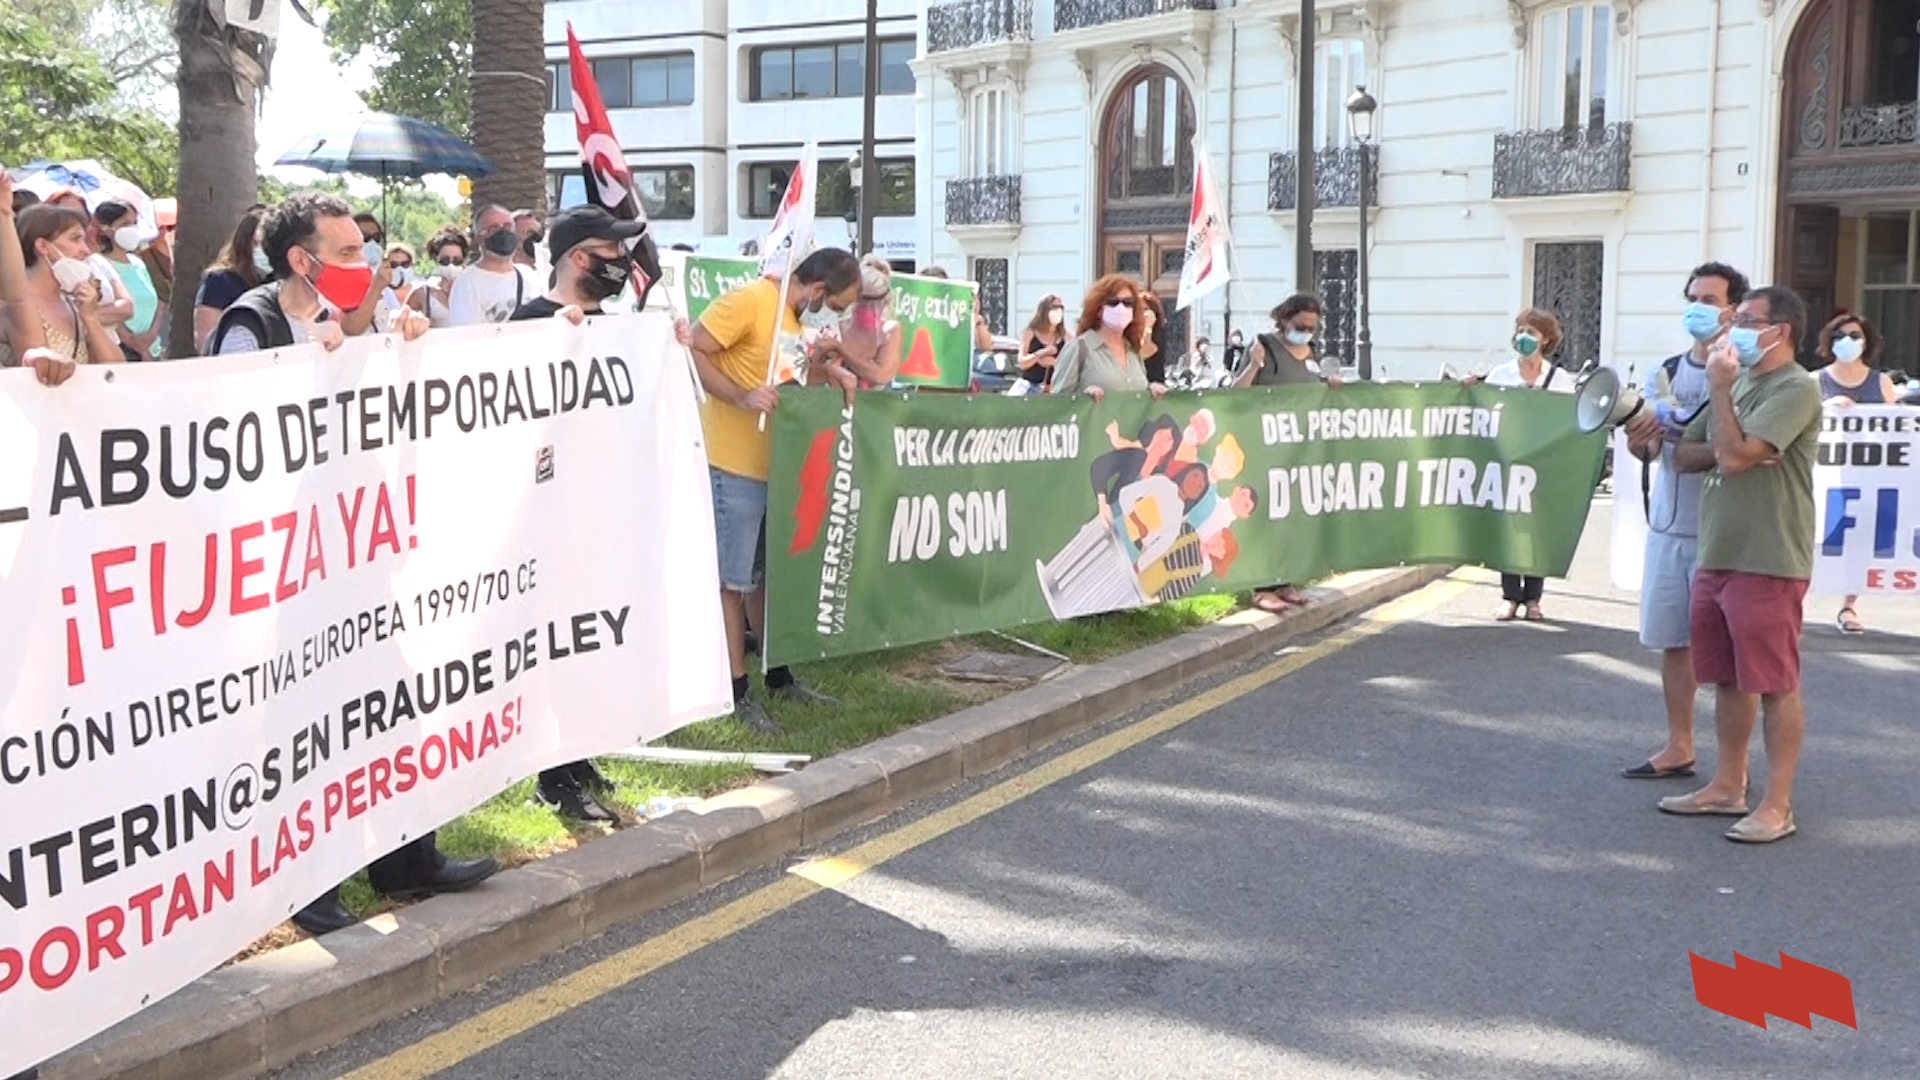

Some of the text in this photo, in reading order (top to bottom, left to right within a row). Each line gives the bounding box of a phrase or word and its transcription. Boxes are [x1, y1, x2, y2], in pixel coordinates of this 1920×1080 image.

[50, 356, 635, 517] ABUSO DE TEMPORALIDAD
[893, 413, 1080, 466] PER LA CONSOLIDACIÓ
[1261, 402, 1505, 445] DEL PERSONAL INTERÍ
[1268, 457, 1538, 521] D'USAR I TIRAR
[61, 474, 418, 687] ¡FIJEZA YA!
[816, 403, 854, 635] INTERSINDICAL
[887, 488, 1008, 563] NO SOM
[1821, 486, 1920, 560] FI
[1, 558, 537, 784] CIÓN DIRECTIVA EUROPEA 1999/70 CE
[292, 713, 330, 784] EN
[341, 649, 495, 750] FRAUDE
[505, 628, 537, 683] DE
[547, 605, 631, 661] LEY
[251, 799, 315, 888] LAS
[323, 695, 524, 834] PERSONAS!
